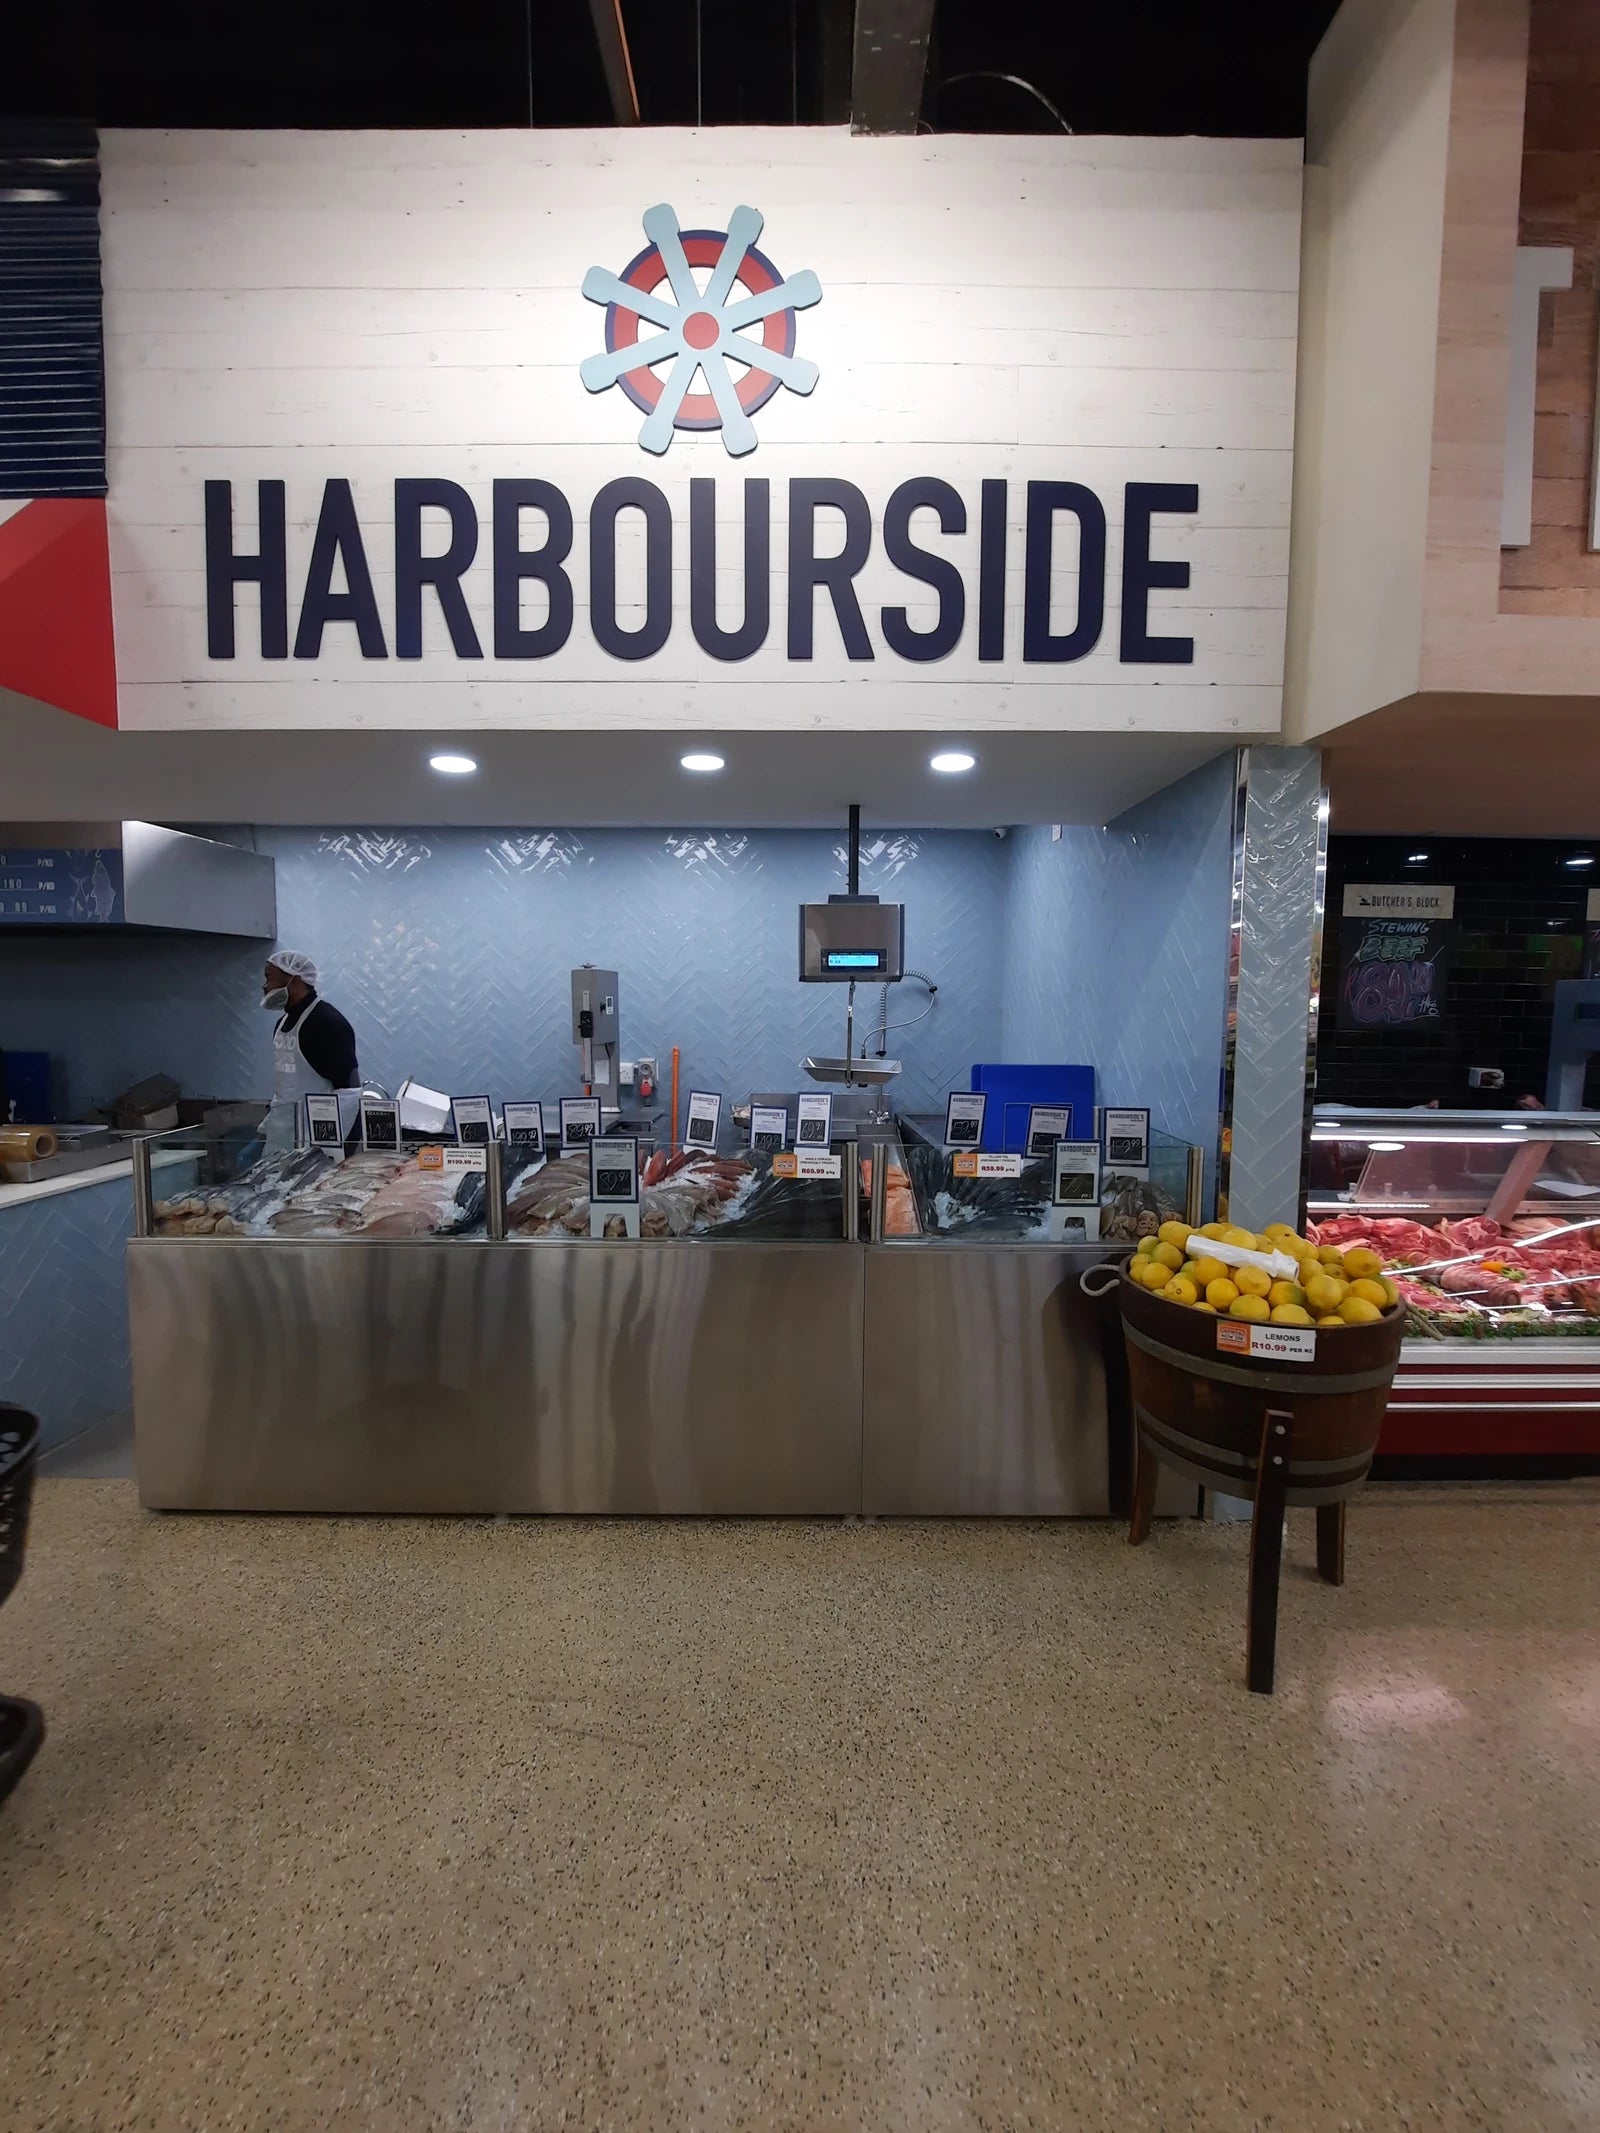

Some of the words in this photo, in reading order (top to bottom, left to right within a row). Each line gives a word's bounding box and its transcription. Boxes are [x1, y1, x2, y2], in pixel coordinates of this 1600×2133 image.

[204, 475, 1198, 664] HARBOURSIDE
[1371, 895, 1414, 908] BUTCHER'S
[1416, 896, 1440, 909] BLOCK
[1359, 934, 1429, 963] BEEF
[1265, 1333, 1301, 1342] LEMONS
[1252, 1341, 1287, 1352] R10.99
